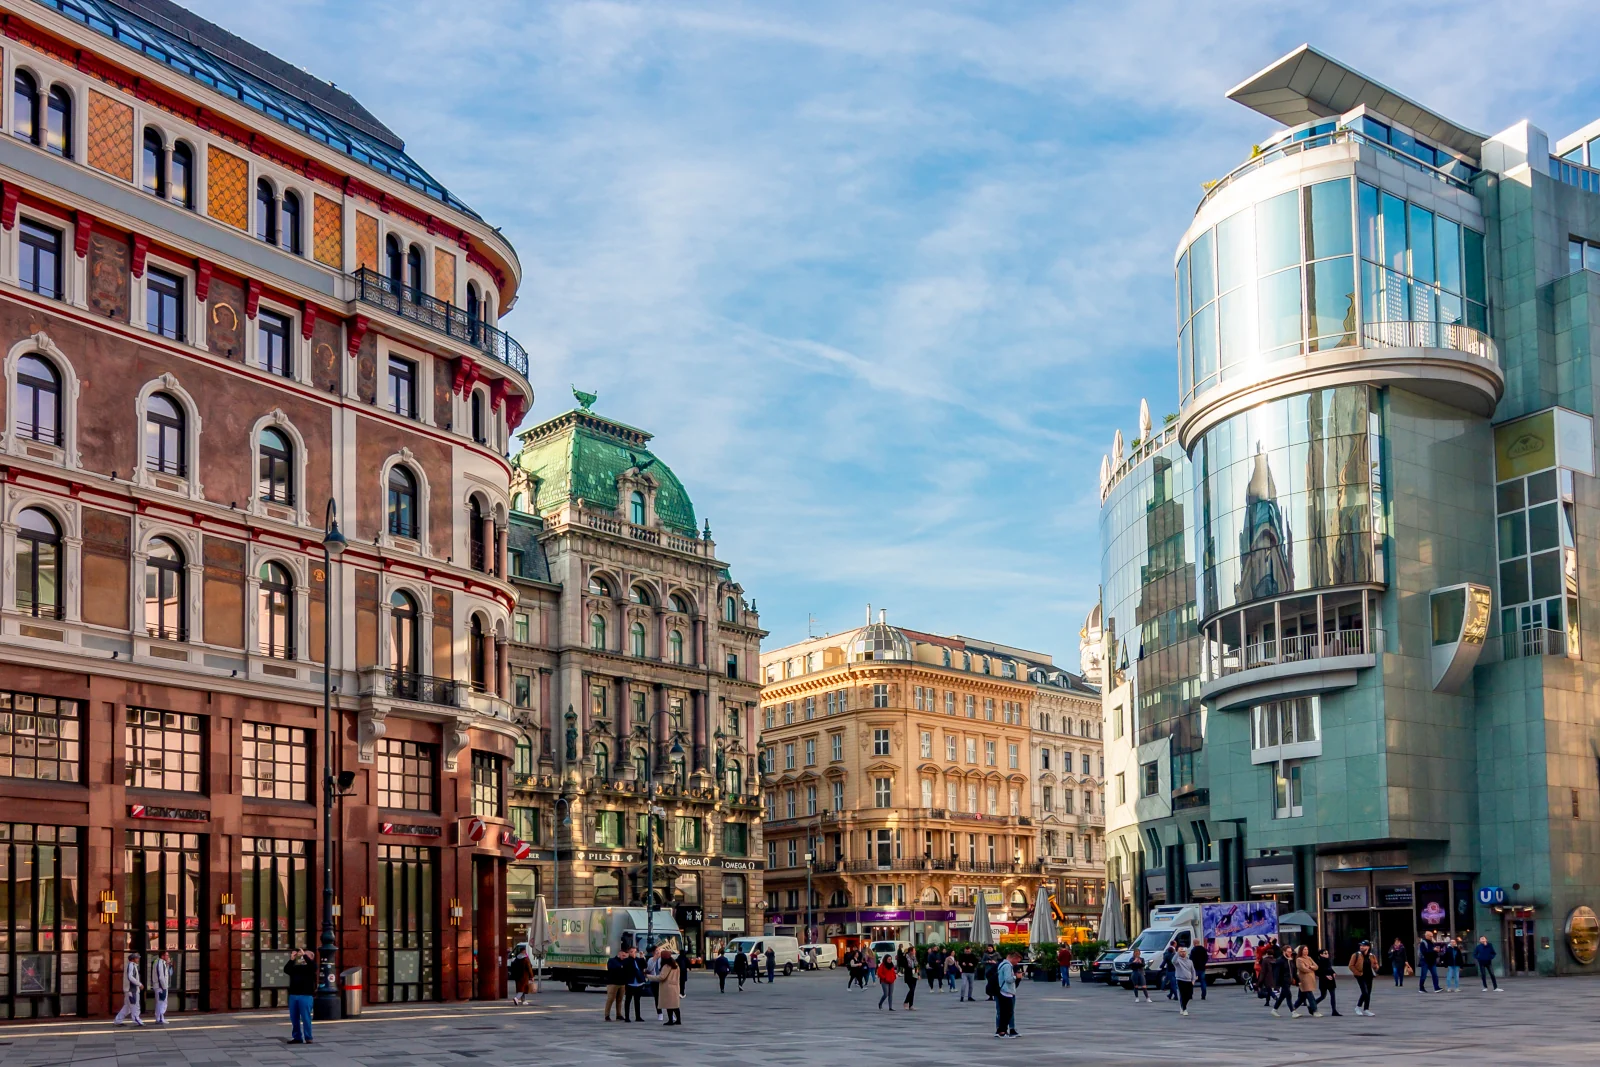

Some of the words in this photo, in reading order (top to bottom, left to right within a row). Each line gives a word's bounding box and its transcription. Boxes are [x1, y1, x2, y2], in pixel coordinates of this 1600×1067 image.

[147, 806, 171, 818] Bank
[174, 809, 208, 820] Austria
[588, 853, 624, 862] PILSTL
[677, 858, 701, 866] OMEGA
[725, 861, 747, 869] OMEGA
[1480, 890, 1492, 903] U
[1496, 890, 1504, 903] U
